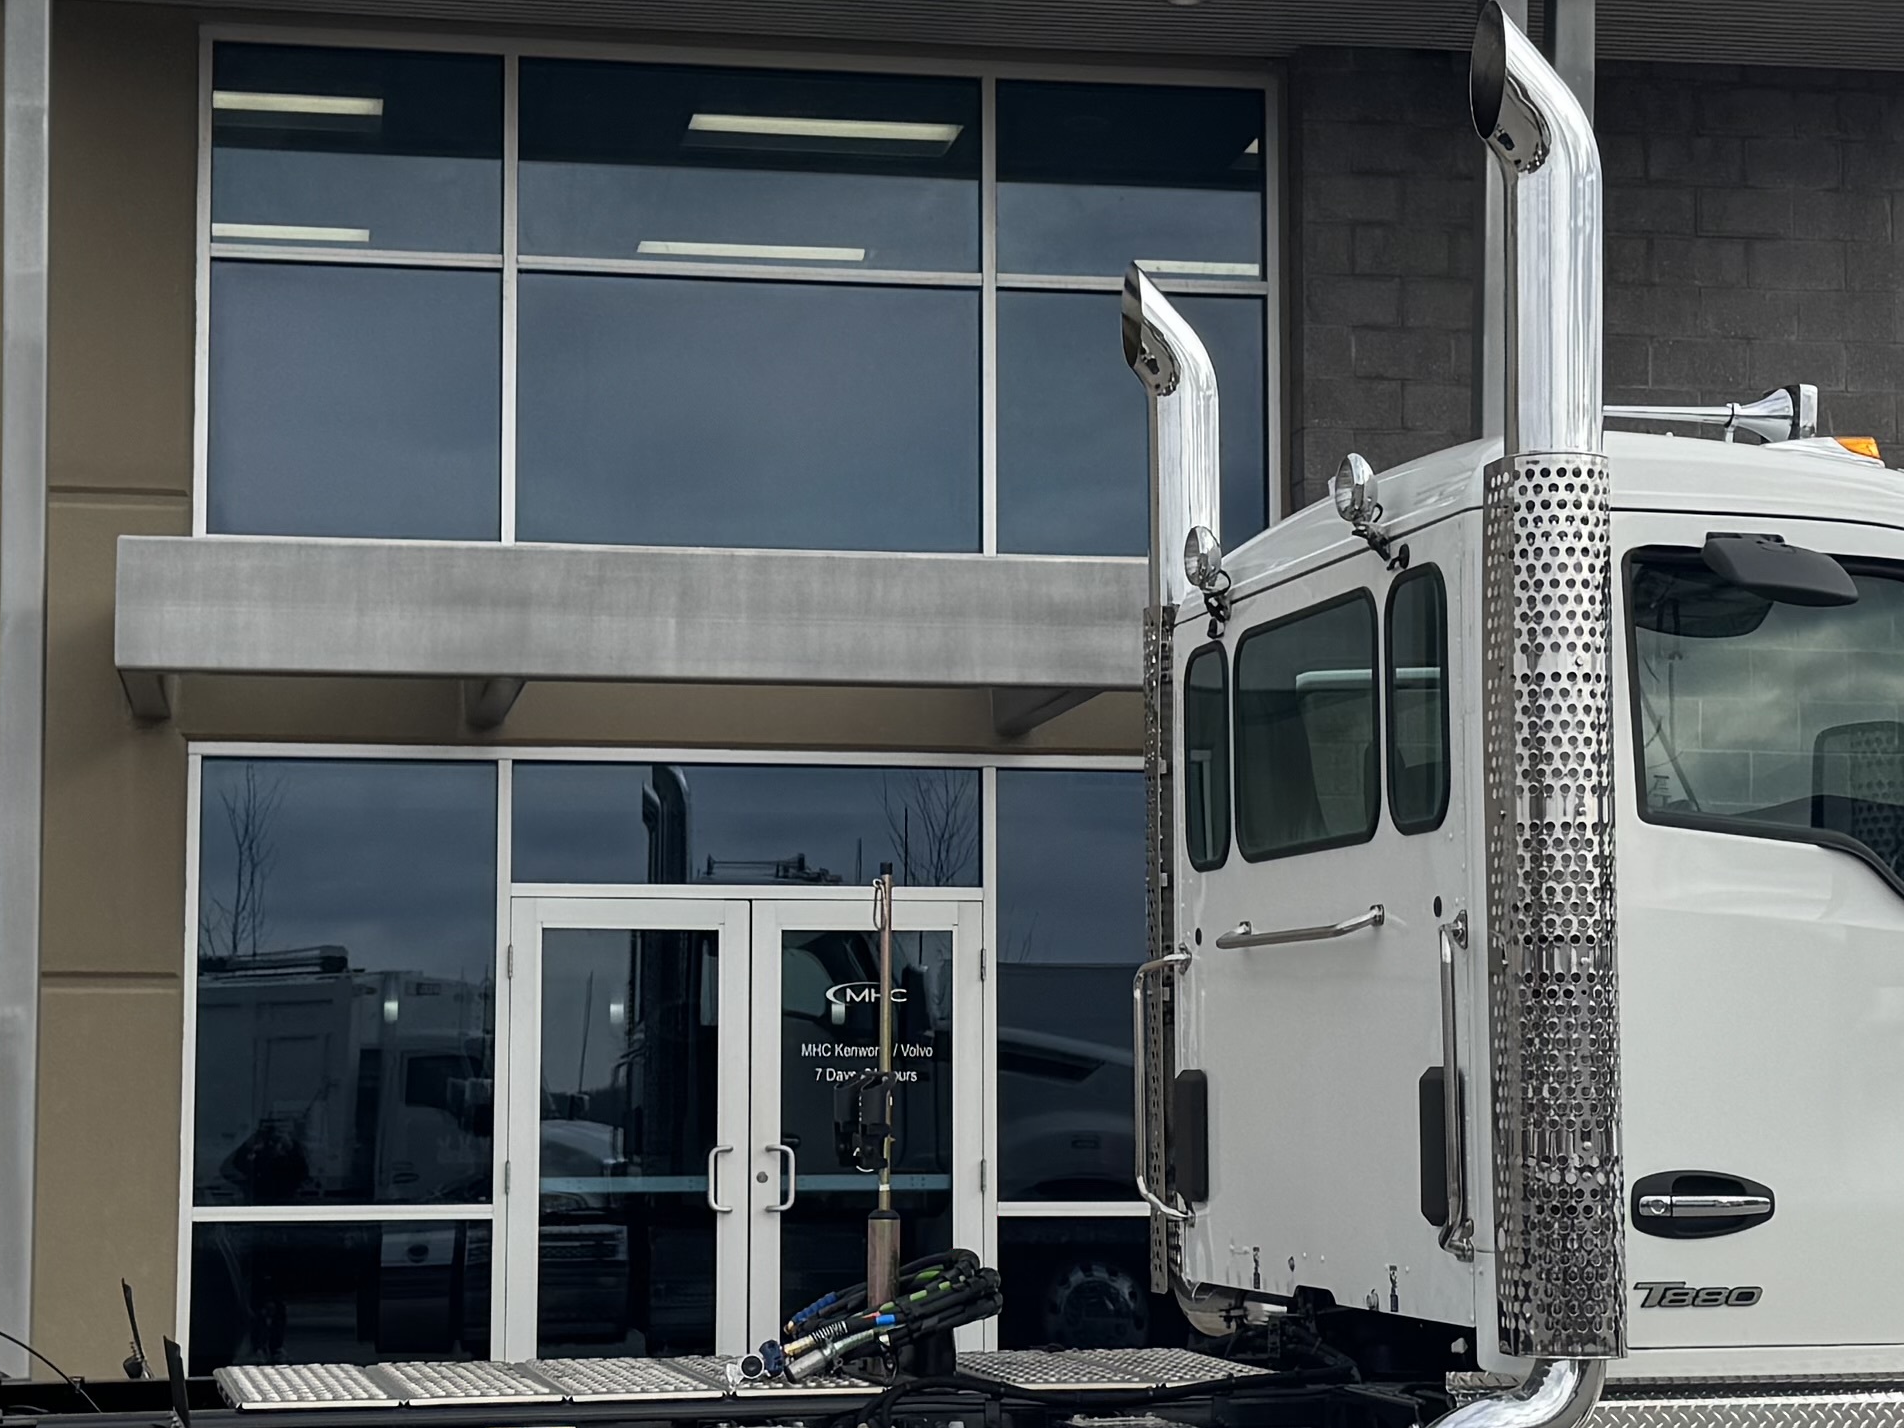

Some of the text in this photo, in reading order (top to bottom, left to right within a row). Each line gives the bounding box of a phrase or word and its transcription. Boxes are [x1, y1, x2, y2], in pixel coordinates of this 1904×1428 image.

[801, 1043, 832, 1057] MHC
[835, 1043, 882, 1057] Kenwor
[901, 1043, 933, 1057] Volvo
[815, 1068, 823, 1081] 7
[1633, 1281, 1764, 1308] T880
